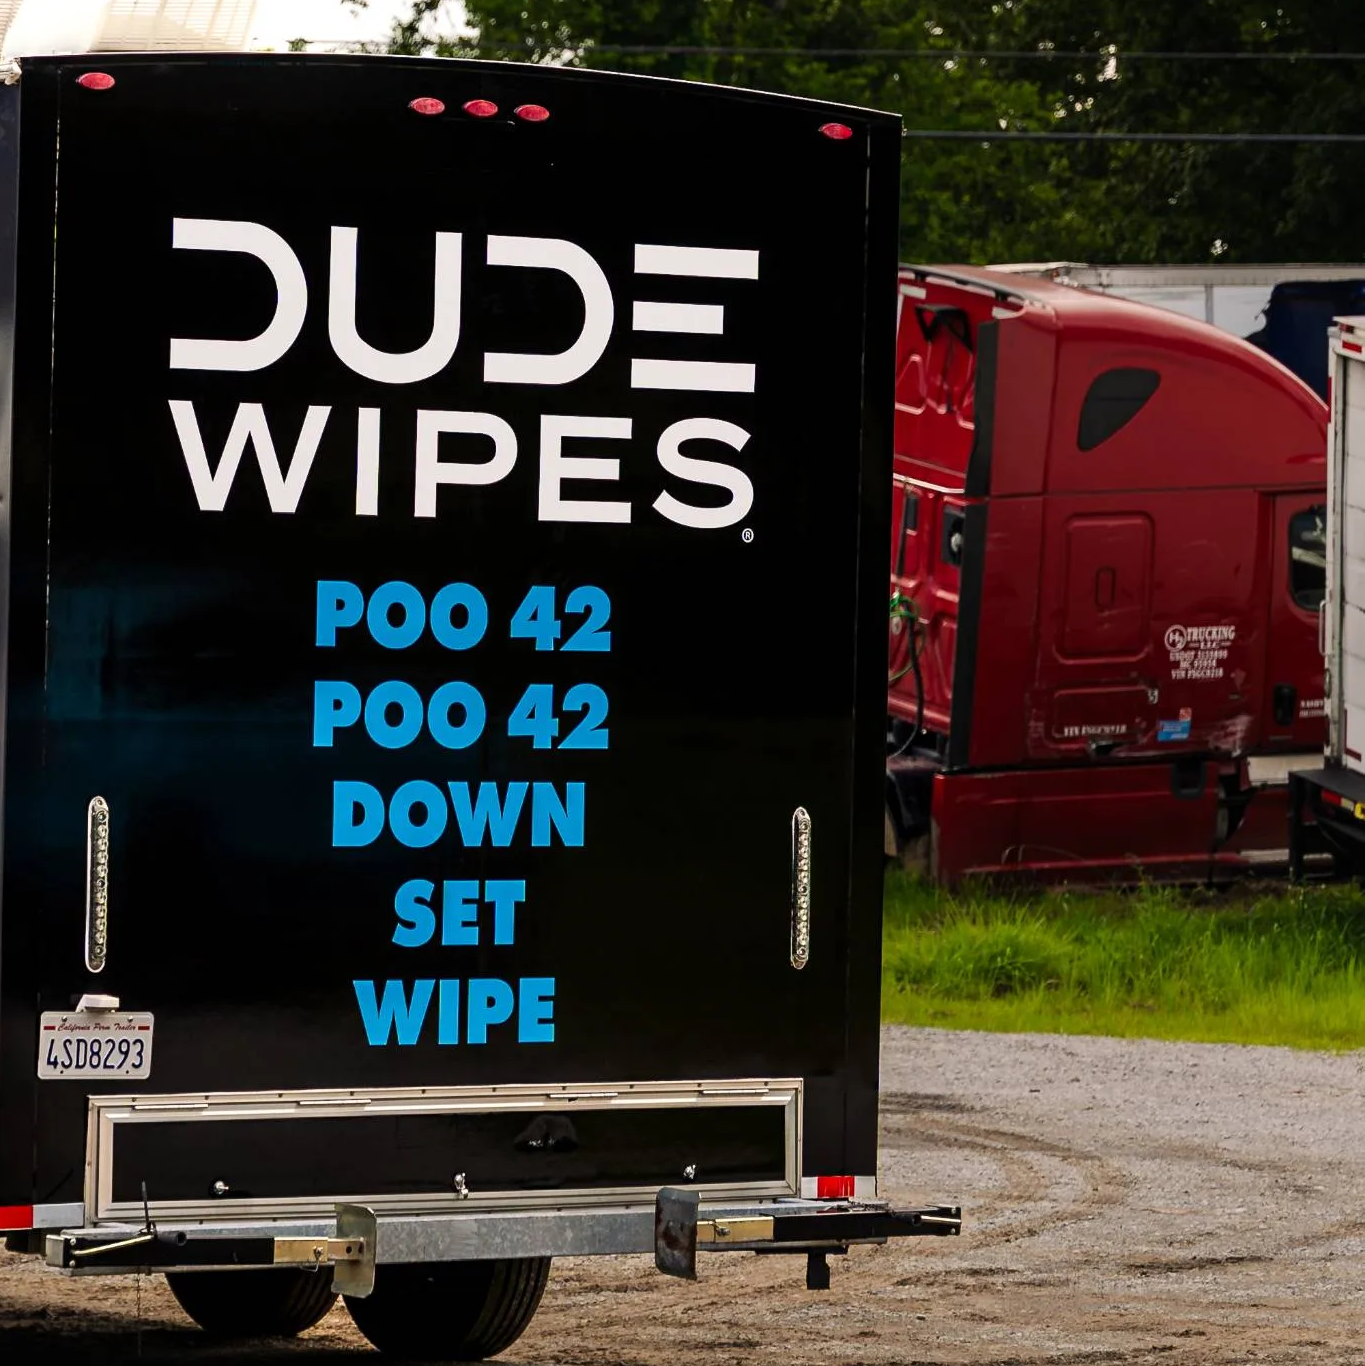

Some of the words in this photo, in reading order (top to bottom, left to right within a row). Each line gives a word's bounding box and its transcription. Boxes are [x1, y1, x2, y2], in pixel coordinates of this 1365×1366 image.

[170, 217, 760, 393] DUDE
[315, 580, 488, 651] POO
[510, 585, 612, 652] 42
[1187, 625, 1235, 641] TRUCKING
[312, 680, 487, 750] POO
[507, 683, 609, 749] 42
[332, 779, 586, 848] DOWN
[391, 879, 526, 948] SET
[57, 1022, 91, 1033] California
[93, 1022, 111, 1032] Perm
[113, 1022, 136, 1032] Trailer
[352, 977, 556, 1046] WIPE
[46, 1038, 145, 1070] 4SD8293
